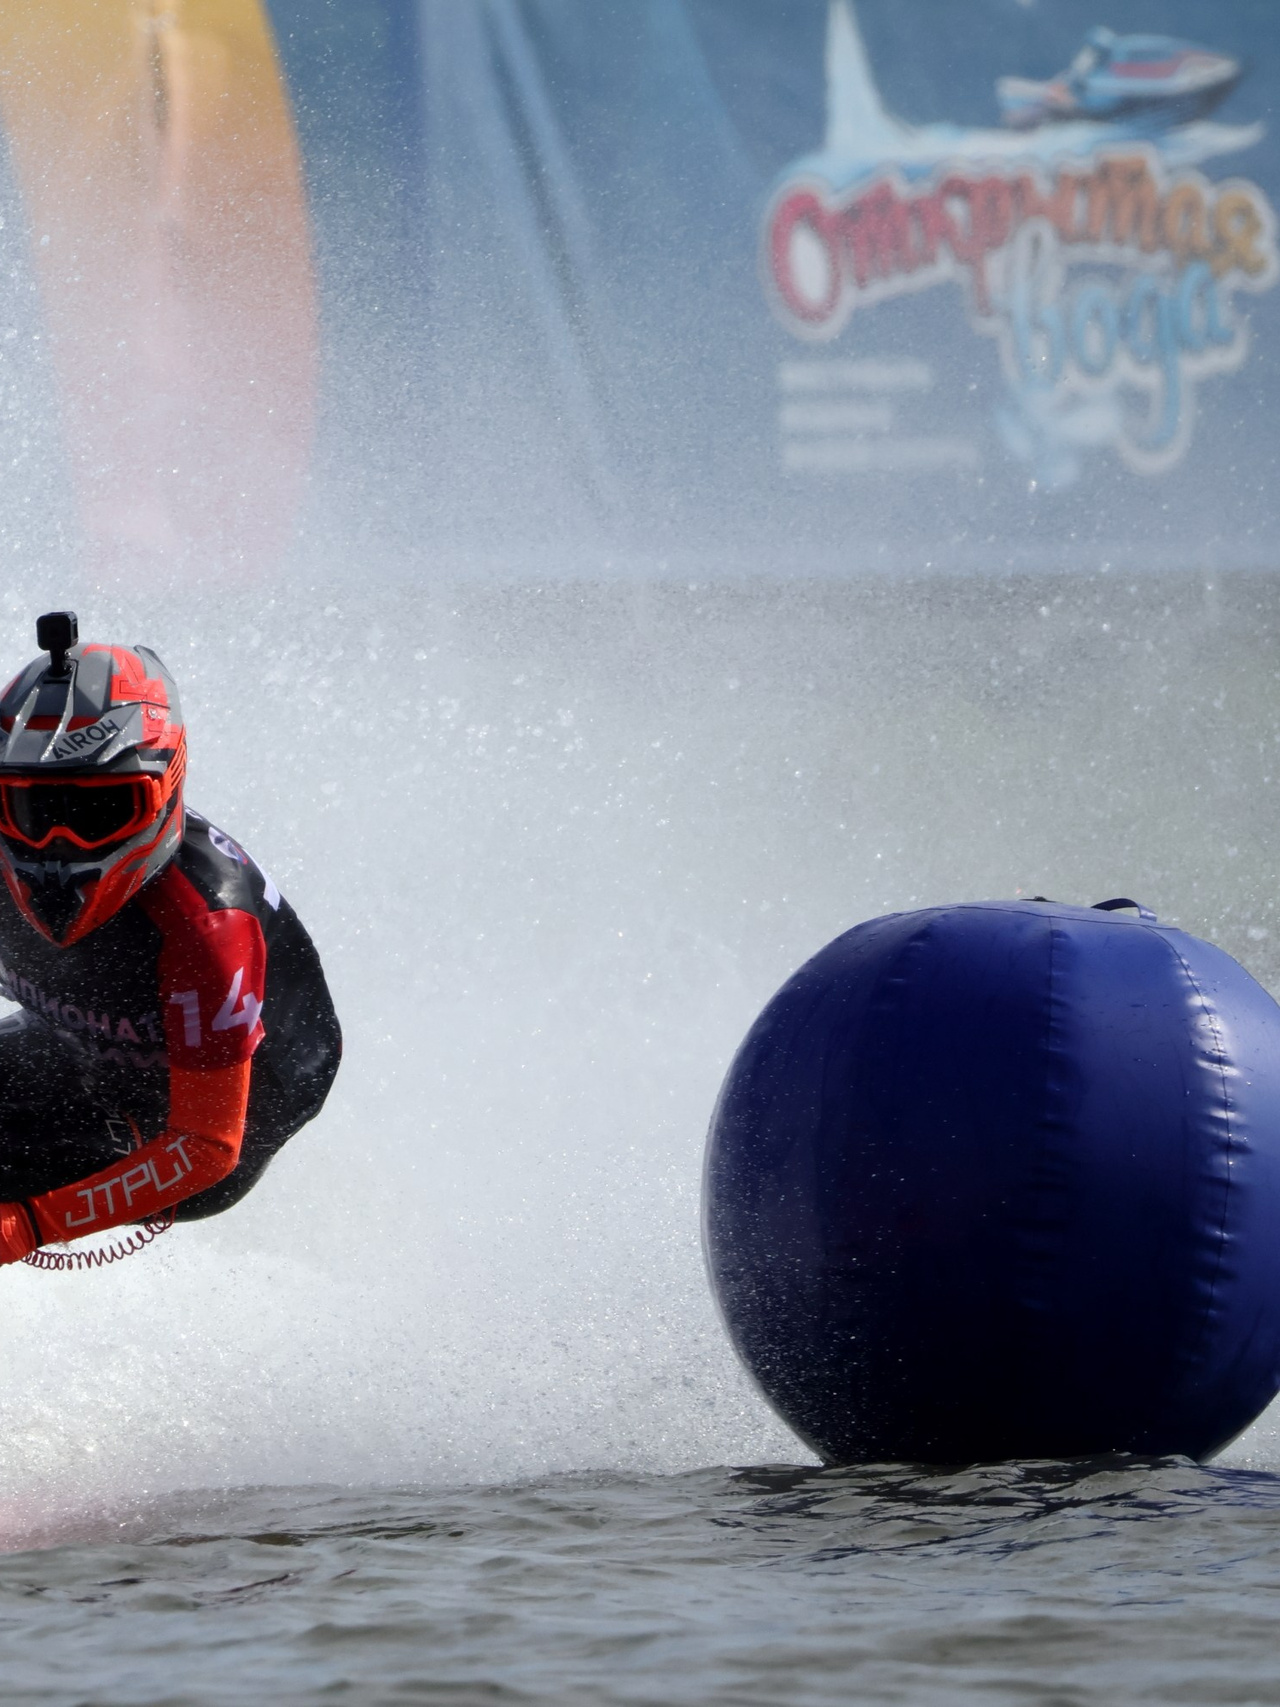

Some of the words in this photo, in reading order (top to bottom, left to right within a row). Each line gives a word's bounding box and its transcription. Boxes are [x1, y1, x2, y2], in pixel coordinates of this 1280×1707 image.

[53, 720, 120, 759] AIROH
[169, 967, 263, 1046] 14
[66, 1136, 193, 1227] JTPLT
